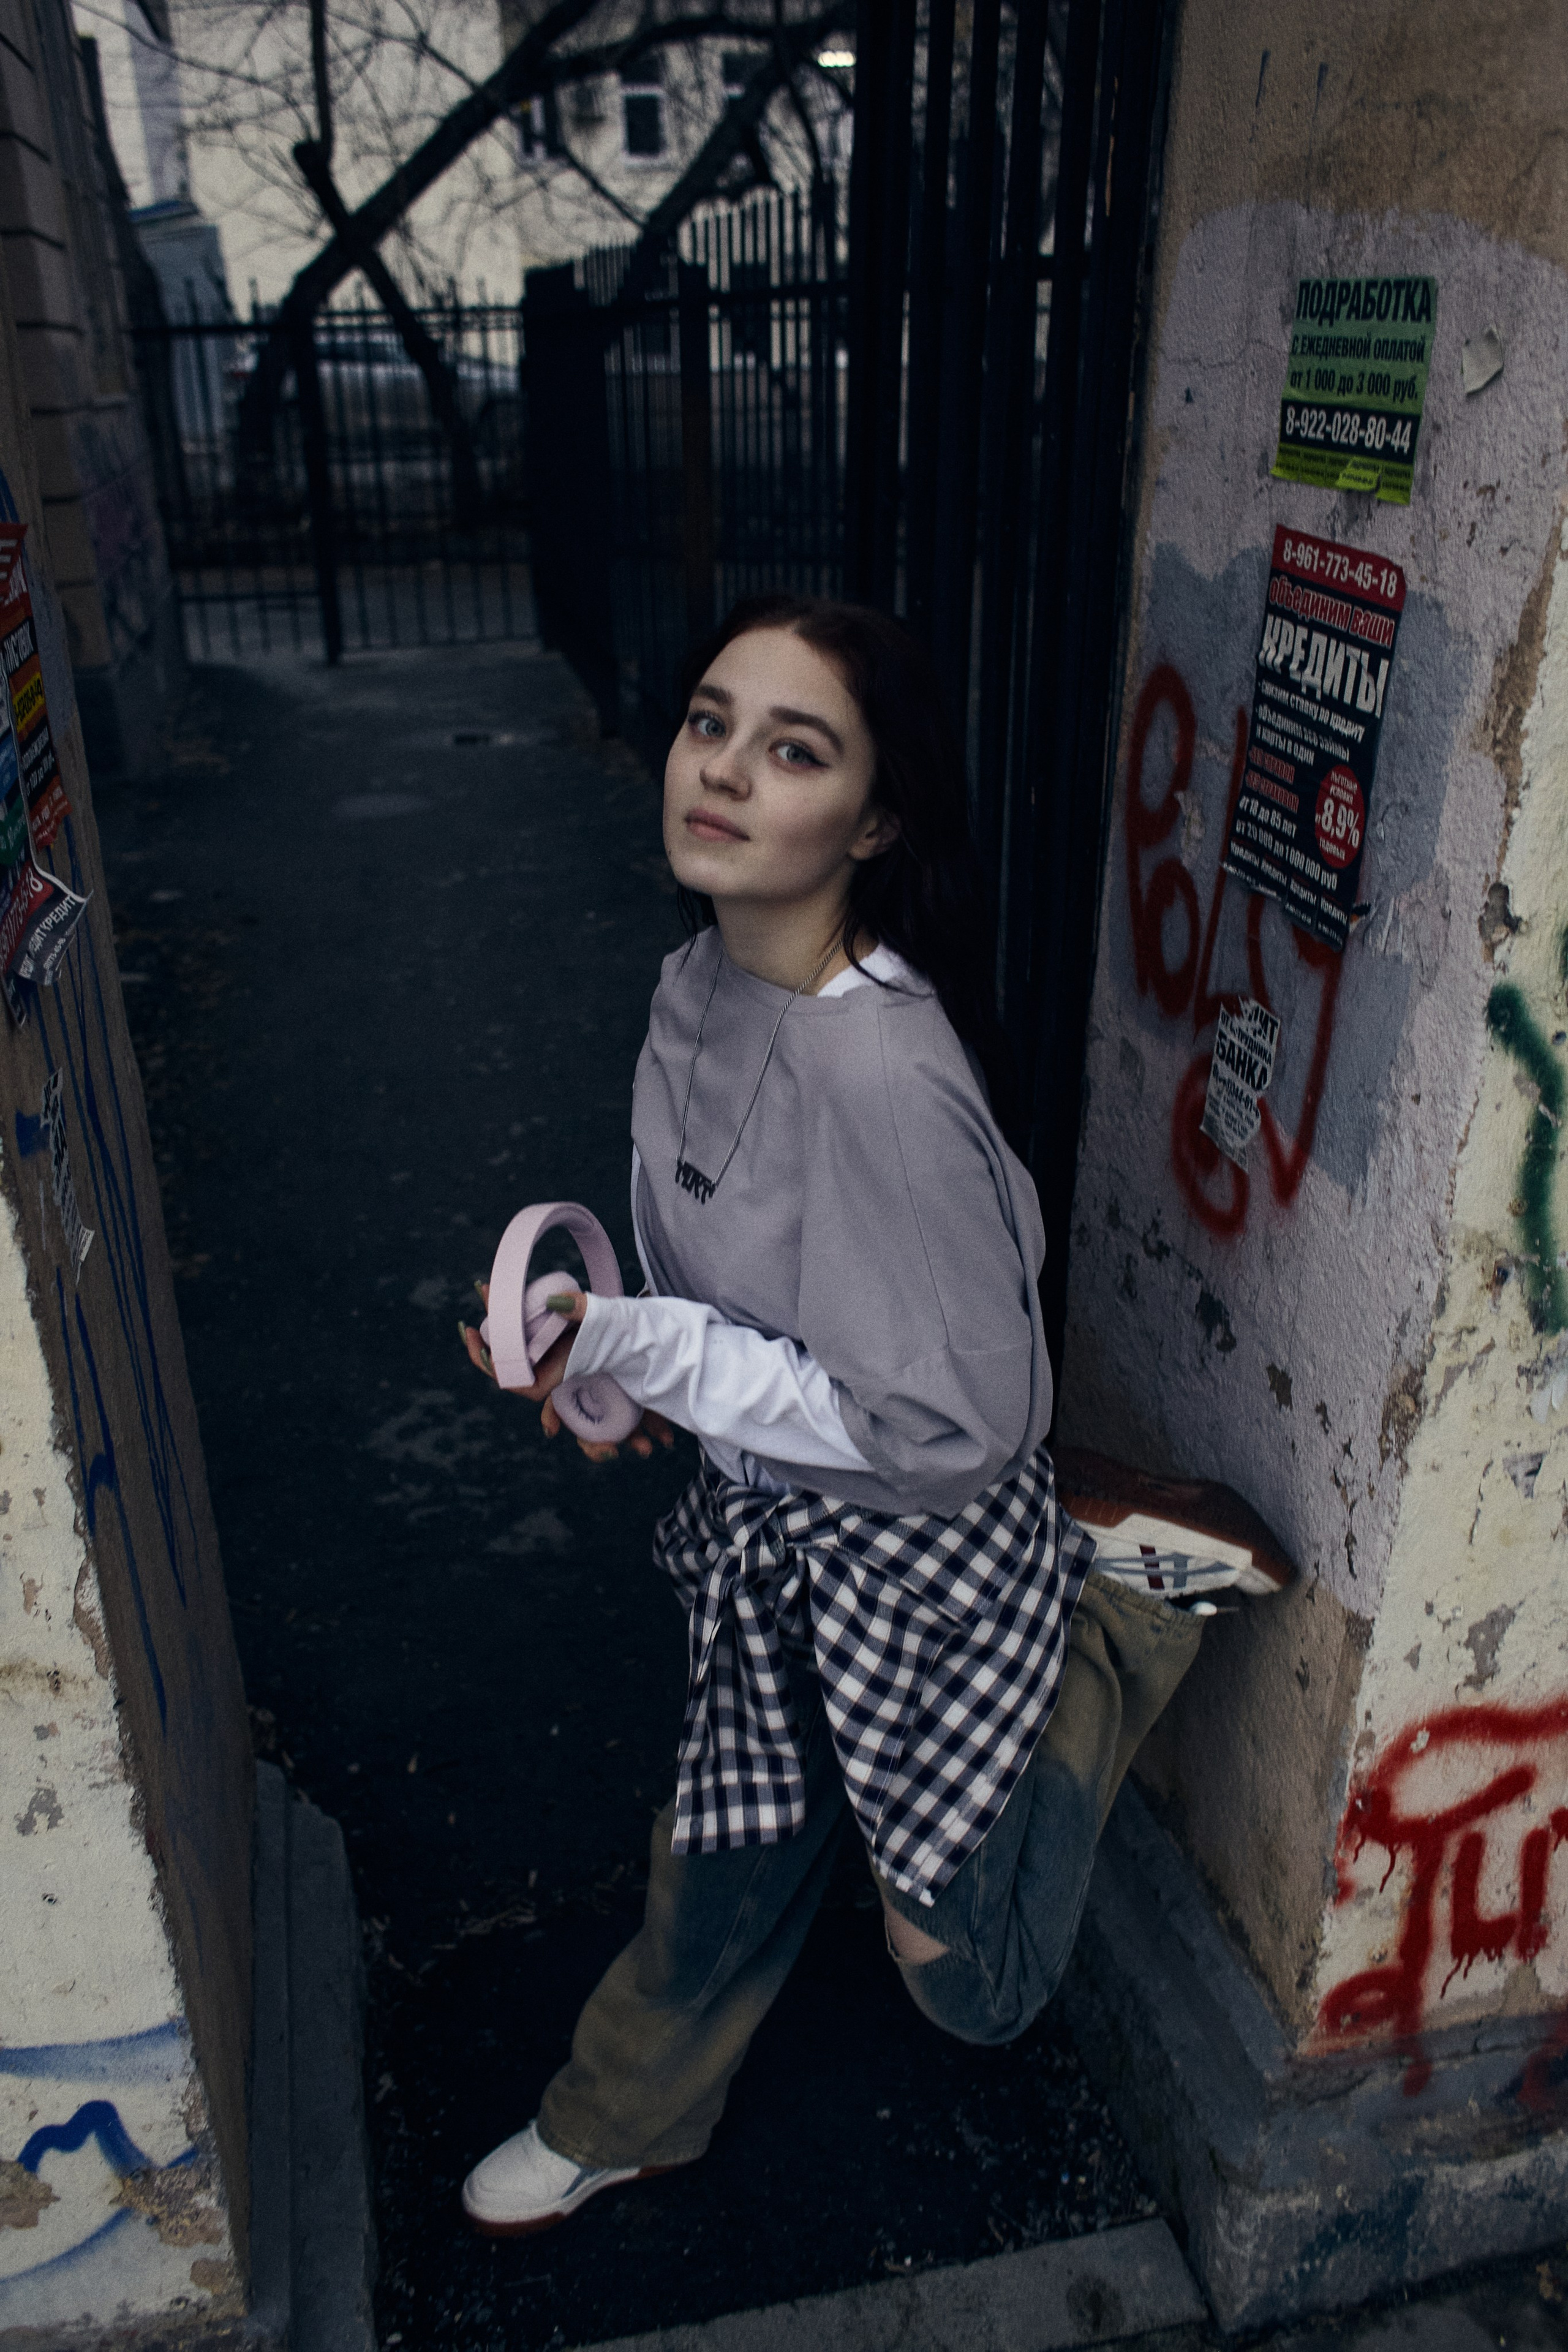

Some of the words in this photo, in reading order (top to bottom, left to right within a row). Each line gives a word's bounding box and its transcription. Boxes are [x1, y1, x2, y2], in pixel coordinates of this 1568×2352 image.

[1295, 280, 1431, 326] ПОДРАБОТКА
[1300, 332, 1371, 360] ЕЖЕДНЕВНОЙ
[1373, 335, 1426, 363] ОПЛАТОЙ
[1290, 371, 1302, 388] от
[1305, 369, 1311, 389] 1
[1315, 369, 1335, 391] 000
[1337, 375, 1354, 396] до
[1356, 371, 1365, 394] 3
[1368, 372, 1390, 396] 000
[1393, 374, 1418, 403] руб.
[1286, 405, 1411, 454] 8-922-028-80-44
[1283, 538, 1398, 598] 8-961-773-45-18
[1259, 613, 1389, 719] КРЕДИТЫ
[1321, 797, 1360, 848] 8,9%
[1216, 1029, 1268, 1090] БАНКА
